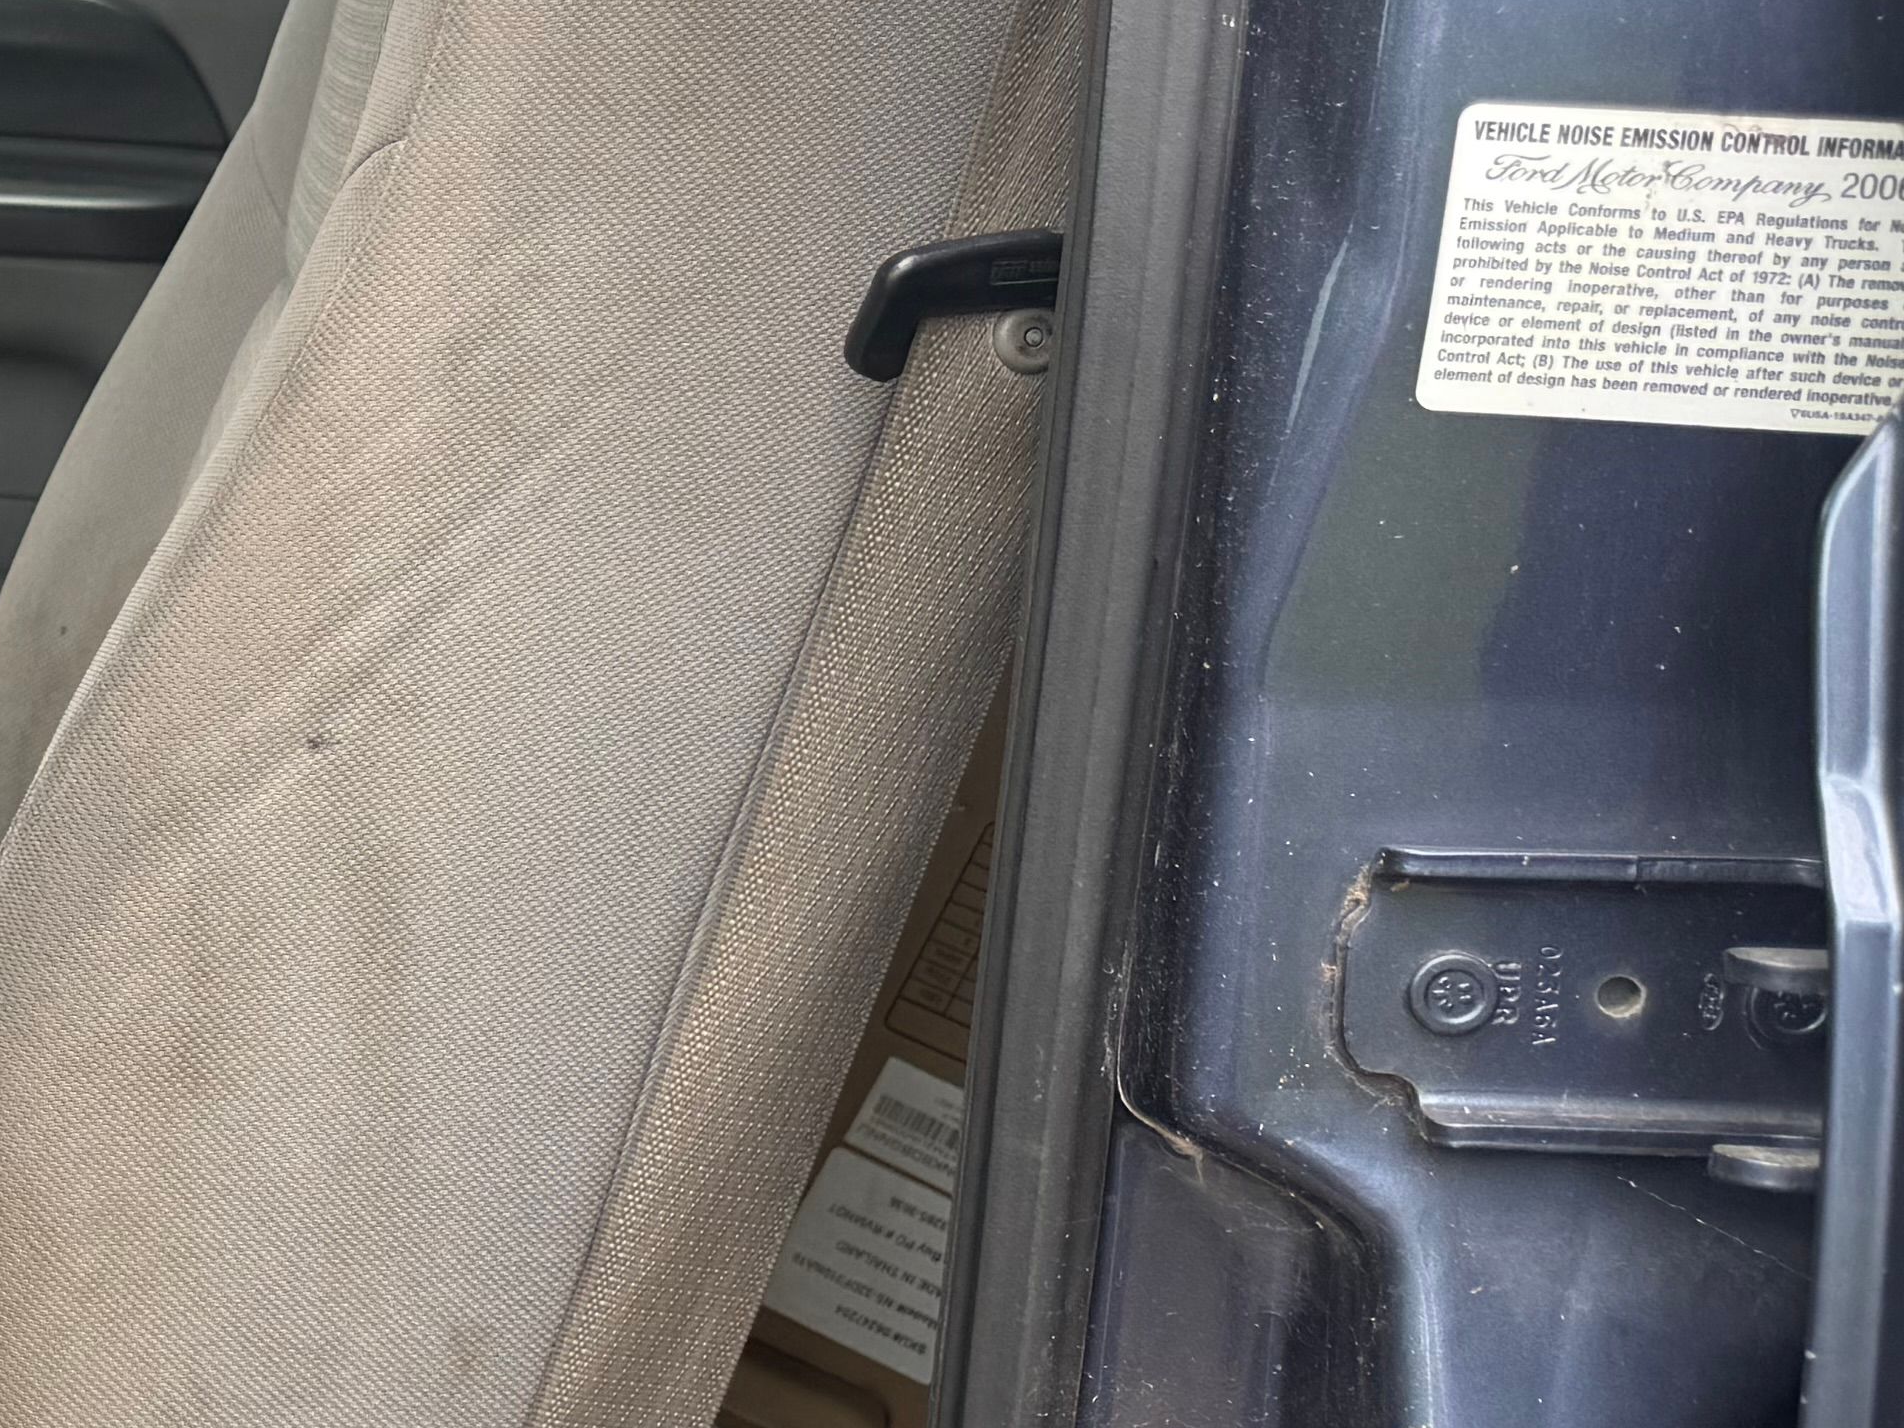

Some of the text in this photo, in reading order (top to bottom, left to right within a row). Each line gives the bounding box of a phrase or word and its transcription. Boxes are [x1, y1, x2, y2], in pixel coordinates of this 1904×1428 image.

[1474, 120, 1551, 143] VEHICLE
[1556, 124, 1614, 146] NOISE
[1619, 126, 1714, 151] EMISSION
[1720, 131, 1810, 156] CONTROL
[1486, 154, 1569, 183] Ford
[1550, 158, 1662, 194] Motor
[1666, 160, 1832, 208] Company
[1464, 197, 1880, 231] This Vehicle Conforms to U.S. EPA Regulations for
[1459, 216, 1878, 251] Emission Applicable to Medium and Heavy Trucks.
[1456, 235, 1891, 271] following acts or the causing thereof by any person
[1452, 256, 1528, 271] prohibited
[1534, 258, 1552, 274] by
[1558, 260, 1582, 274] the
[1588, 261, 1630, 276] Noise
[1636, 263, 1691, 279] Control
[1697, 267, 1723, 282] Act
[1729, 269, 1745, 282] of
[1753, 270, 1791, 285] 1972:
[1798, 273, 1820, 289] (A)
[1828, 274, 1855, 288] The
[1447, 293, 1851, 327] maintenance, repair, or replacement, of any noise
[1449, 276, 1889, 311] or rendering inoperative, other than for purposes
[1443, 311, 1490, 326] device
[1498, 316, 1514, 327] or
[1521, 315, 1581, 331] element
[1588, 319, 1604, 332] of
[1611, 320, 1661, 337] design
[1670, 323, 1717, 339] (listed
[1725, 327, 1739, 340] in
[1748, 328, 1772, 342] the
[1780, 332, 1840, 346] owner's
[1440, 330, 1534, 347] incorporated
[1541, 335, 1570, 349] into
[1578, 338, 1605, 351] this
[1614, 340, 1667, 355] vehicle
[1674, 343, 1688, 356] in
[1696, 346, 1784, 362] compliance
[1792, 351, 1825, 364] with
[1833, 352, 1857, 366] the
[1433, 367, 1802, 401] element of design has been removed or rendered
[1437, 348, 1904, 388] Control Act; (B) The use of this vehicle after such device or
